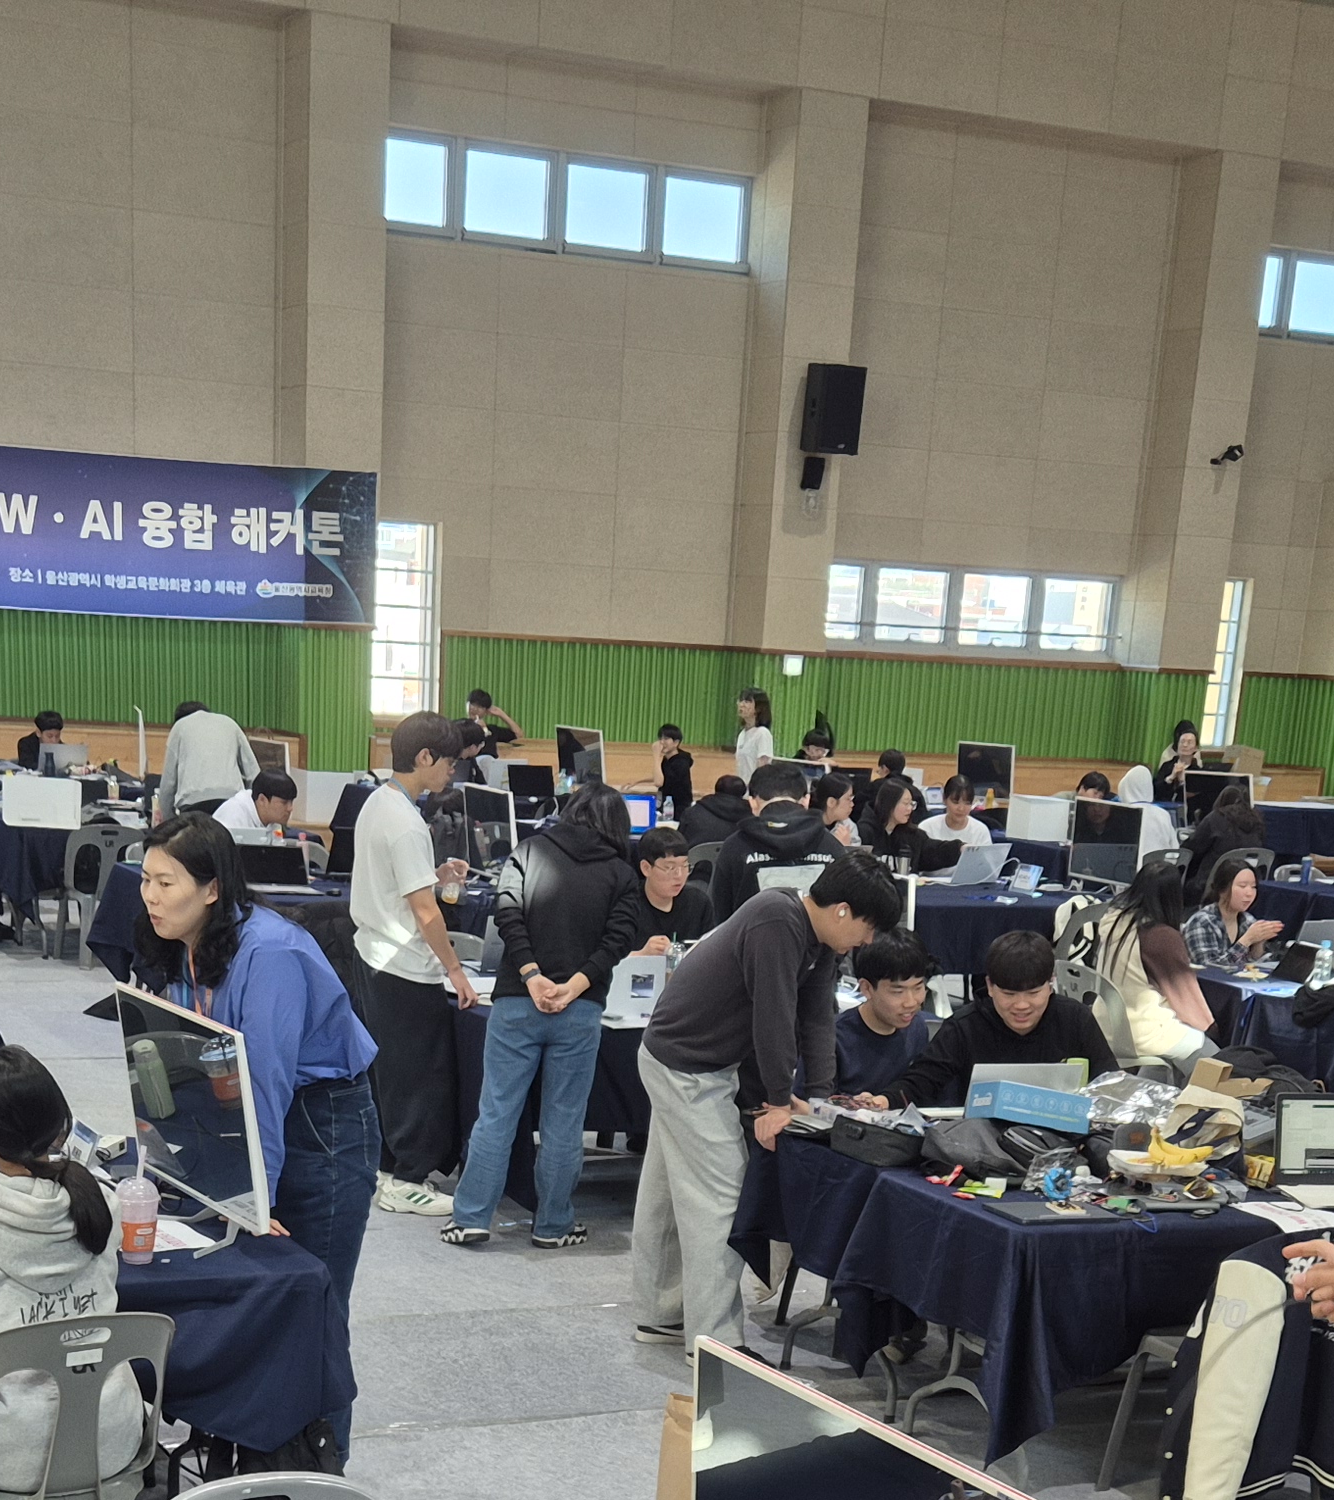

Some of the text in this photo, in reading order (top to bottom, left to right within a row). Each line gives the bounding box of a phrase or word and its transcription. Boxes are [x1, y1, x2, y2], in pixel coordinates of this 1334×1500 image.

[79, 499, 123, 541] AI
[138, 501, 218, 550] 융합
[230, 507, 344, 556] 해커톤
[8, 566, 34, 583] 장소
[746, 852, 778, 865] Alas
